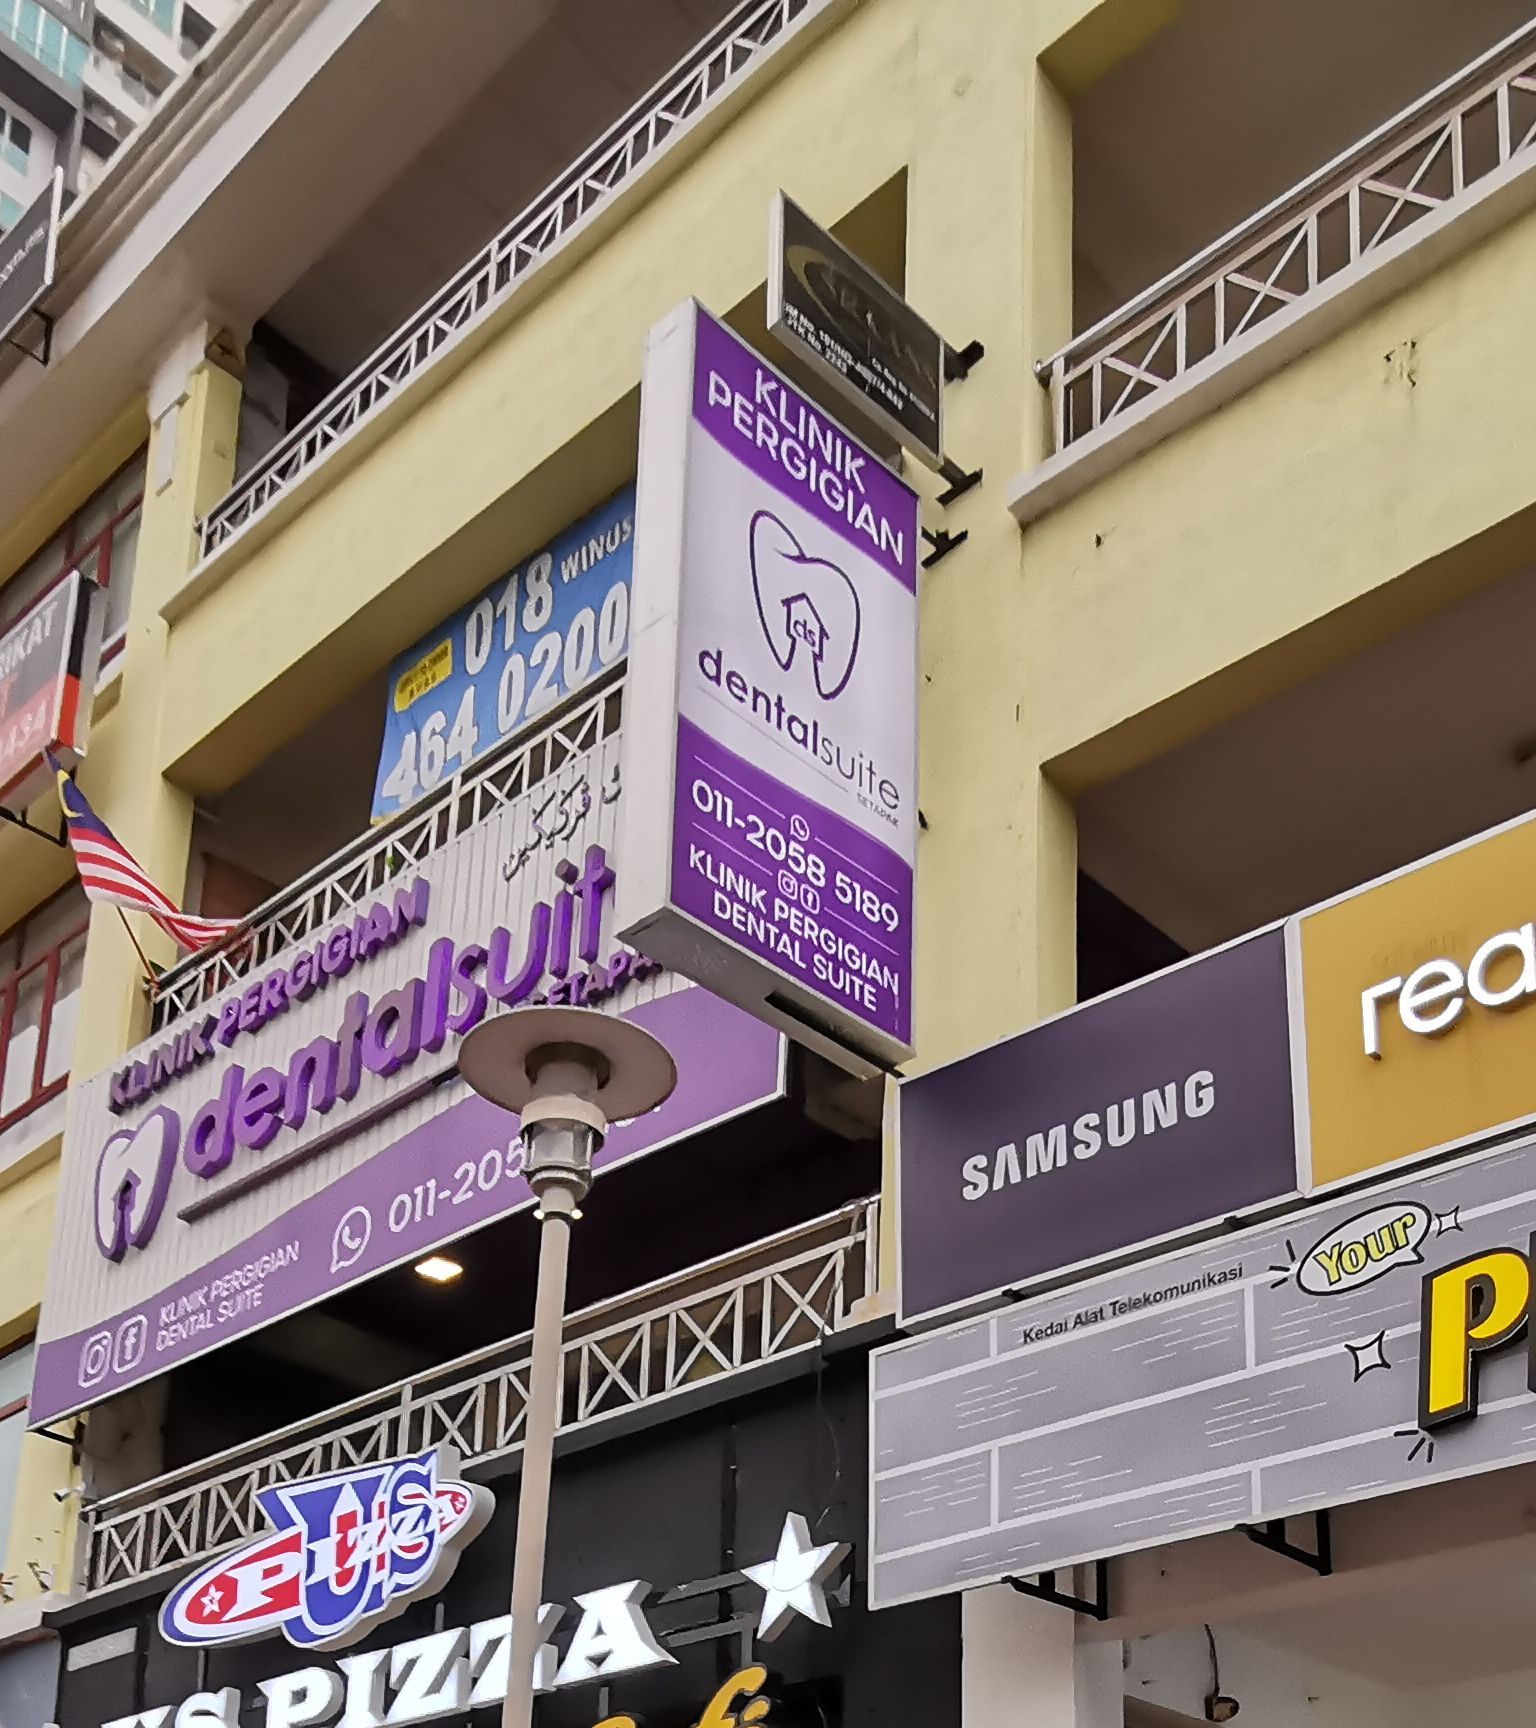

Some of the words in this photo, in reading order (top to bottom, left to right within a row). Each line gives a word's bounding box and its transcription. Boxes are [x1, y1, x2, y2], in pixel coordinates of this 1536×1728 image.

[708, 369, 904, 566] PERGIGIAN
[755, 367, 866, 495] KLINIK
[465, 551, 554, 676] 018
[560, 515, 633, 584] WINUS
[381, 684, 478, 810] 464
[497, 581, 629, 738] 0200
[697, 647, 900, 811] dentalsuite
[688, 843, 768, 914] KLINIK
[773, 897, 899, 996] PERGIGIAN
[691, 778, 827, 888] 011-2058
[834, 870, 900, 933] 5189
[108, 1013, 219, 1117] KLINIK
[216, 876, 431, 1048] PERGIGIAN
[183, 843, 617, 1180] dentalsuit
[713, 889, 807, 970] DENTAL
[812, 952, 877, 1012] SUITE
[388, 1136, 525, 1234] 011-205
[961, 1069, 1216, 1201] SAMSUNG
[155, 1308, 215, 1352] DENTAL
[216, 1282, 265, 1324] SUITE
[1021, 1320, 1069, 1345] Kedai
[1072, 1308, 1105, 1331] Alat
[1108, 1262, 1244, 1320] Telekomunikasi
[1313, 1210, 1418, 1287] Your
